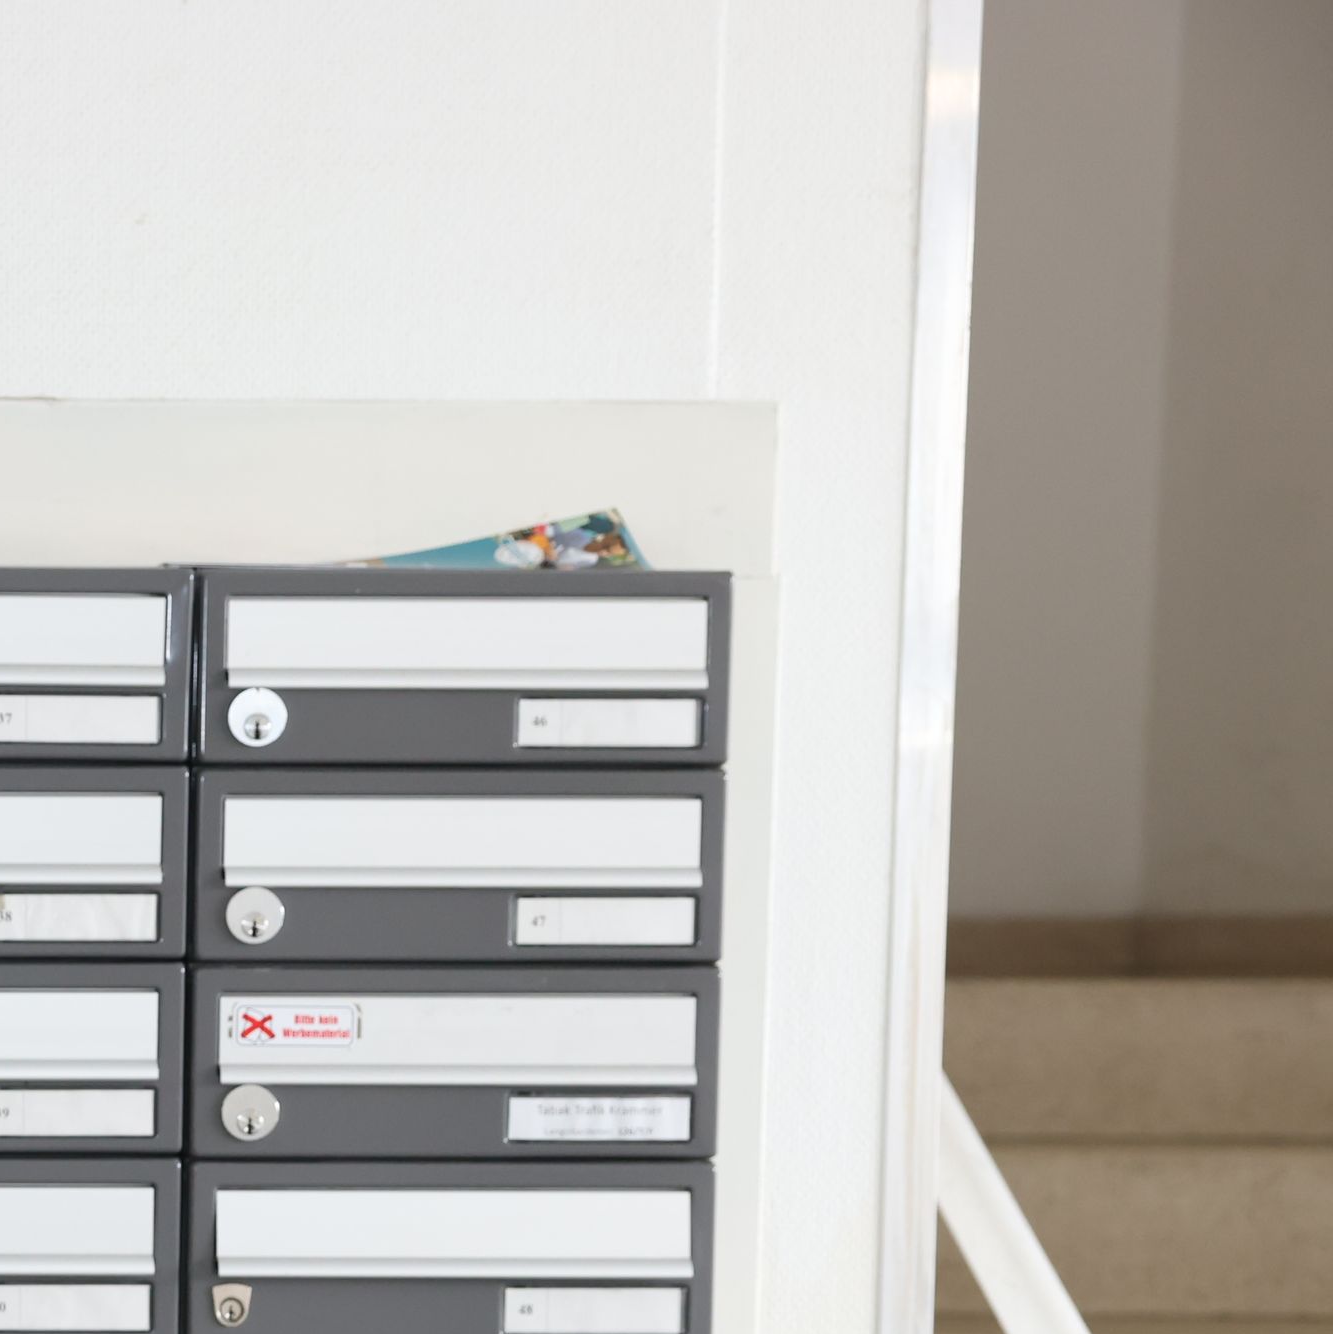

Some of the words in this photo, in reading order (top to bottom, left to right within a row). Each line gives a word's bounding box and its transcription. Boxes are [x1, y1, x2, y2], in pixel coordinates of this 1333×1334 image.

[532, 716, 548, 727] 46
[531, 915, 546, 927] 47
[294, 1014, 315, 1025] Bitte
[318, 1014, 338, 1025] kein
[282, 1027, 351, 1039] Werbematerial
